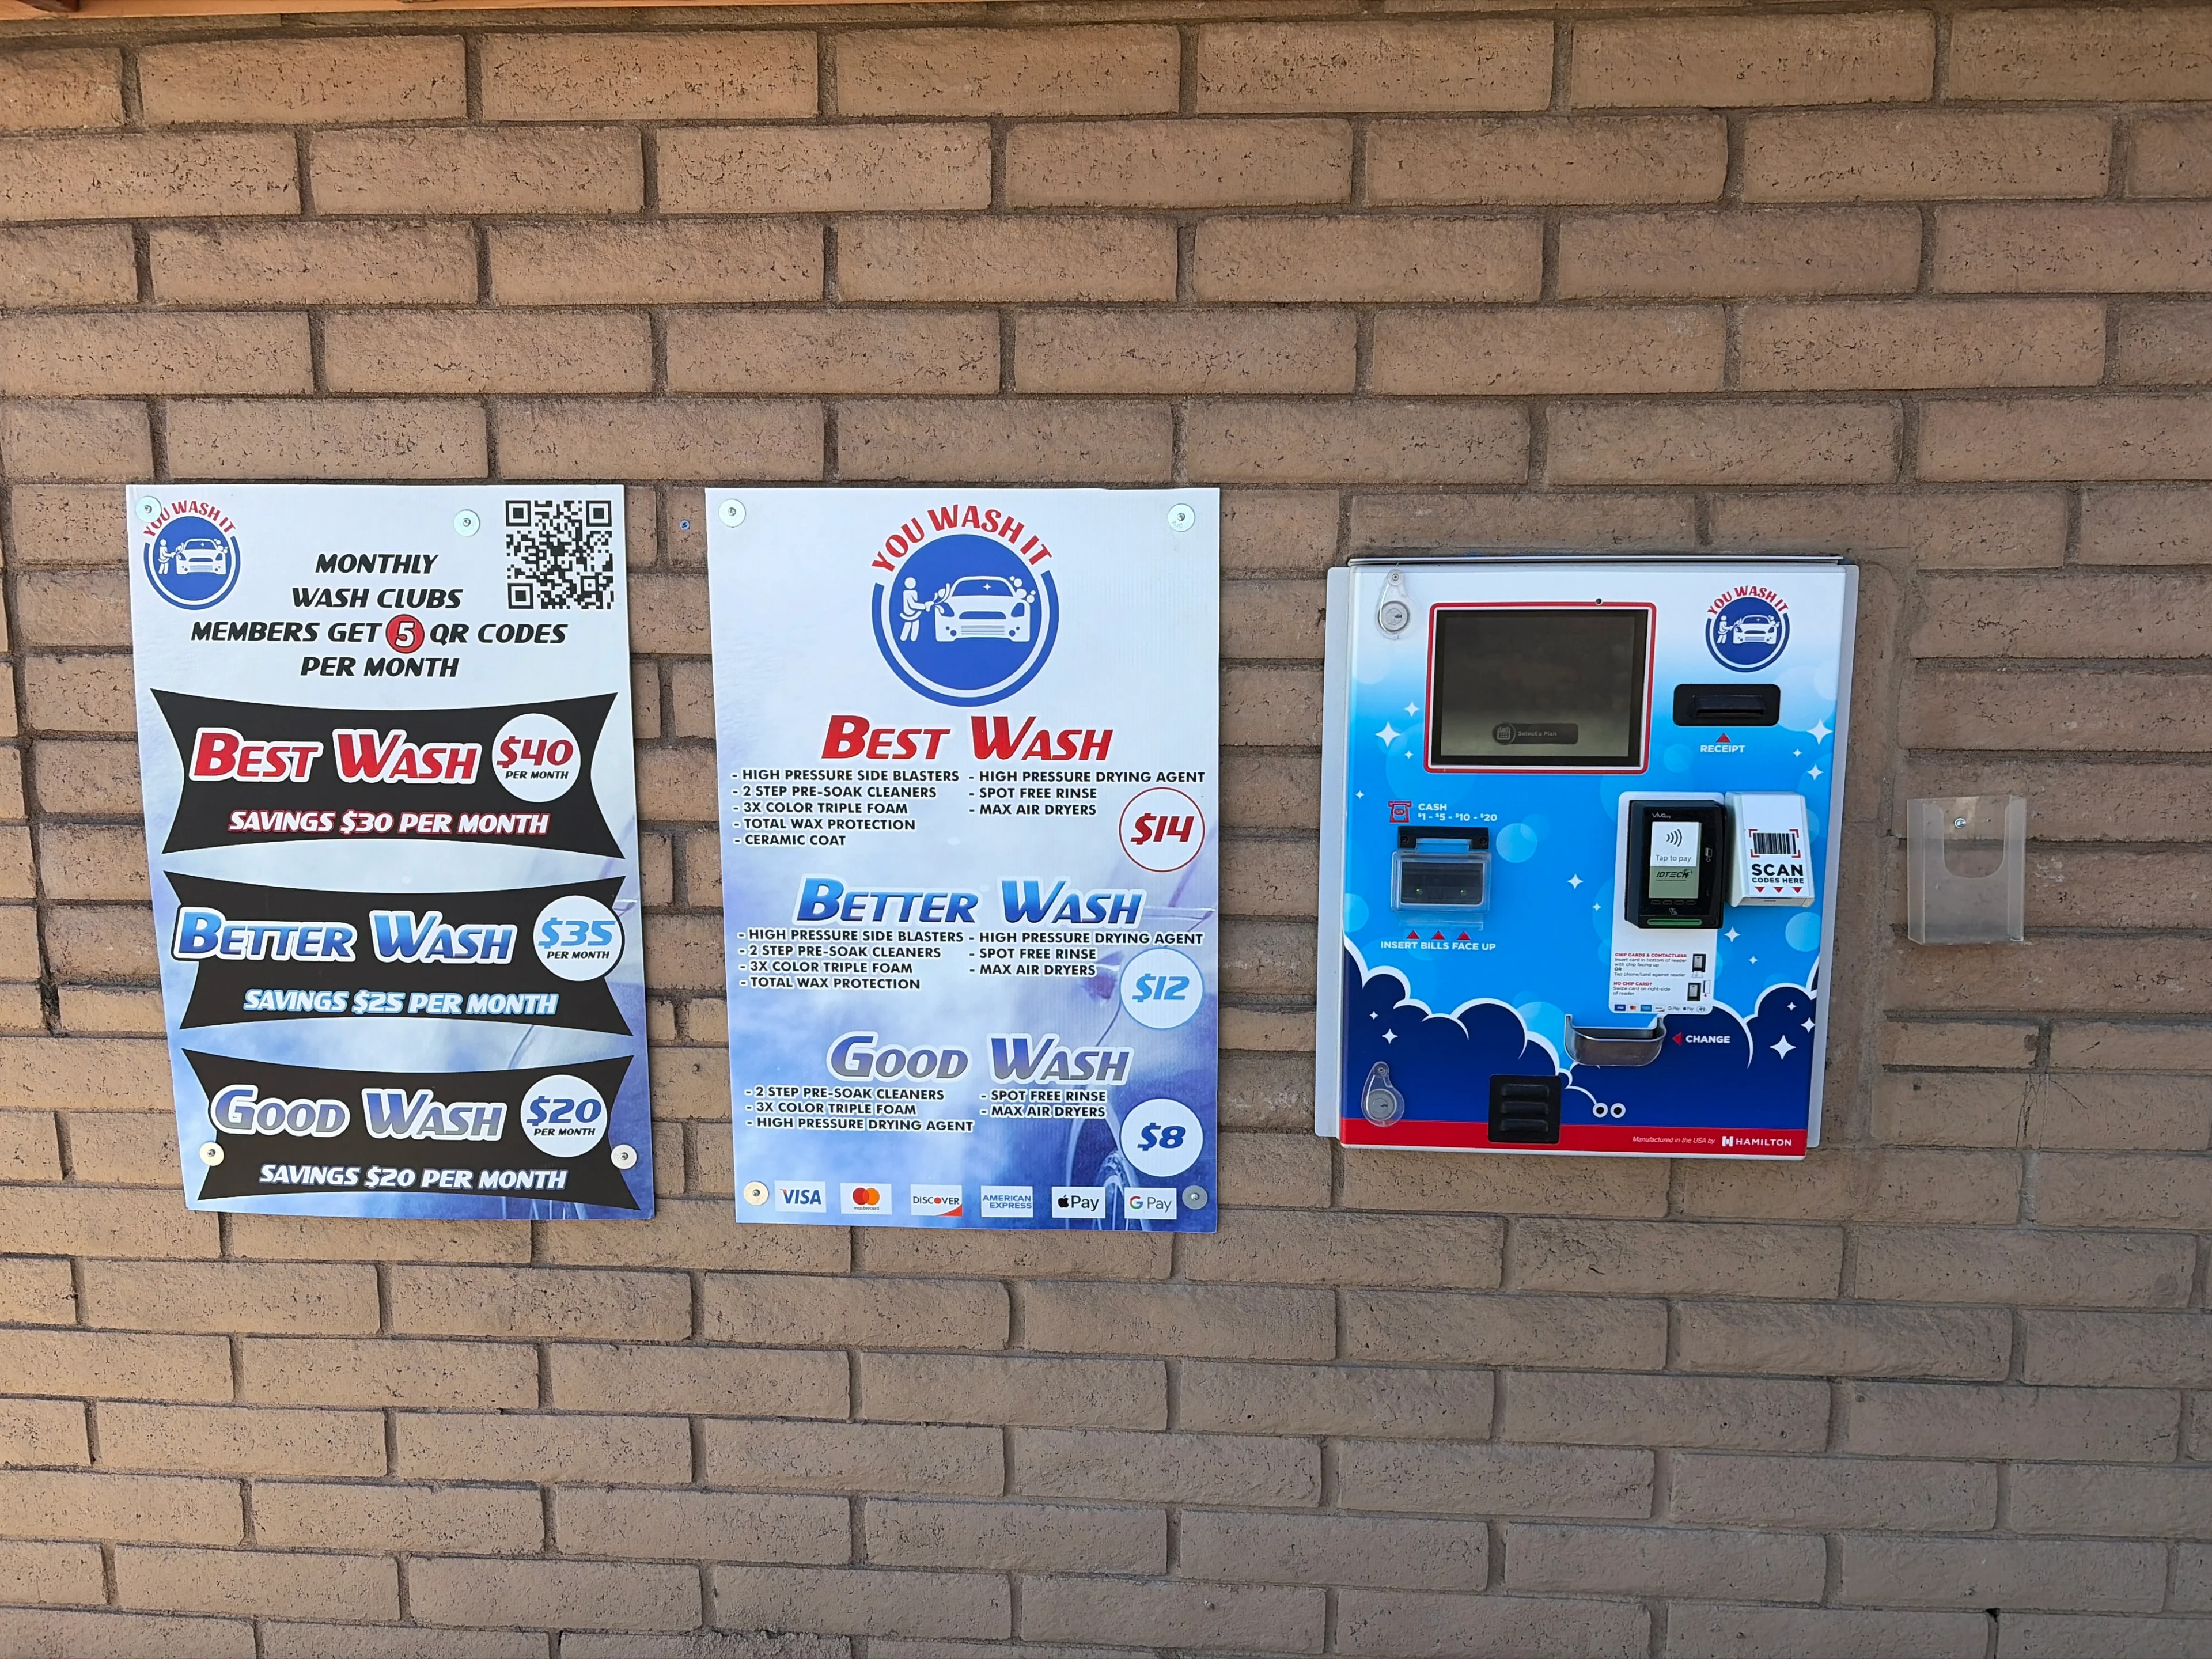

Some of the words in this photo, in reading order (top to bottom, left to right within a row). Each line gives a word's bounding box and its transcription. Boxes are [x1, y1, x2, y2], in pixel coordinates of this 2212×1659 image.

[172, 500, 221, 521] WASH
[219, 517, 236, 532] IT
[871, 518, 925, 572] YOU
[927, 504, 1024, 544] WASH
[1020, 535, 1052, 565] IT
[315, 553, 439, 574] MONTHLY
[293, 588, 370, 608] WASH
[377, 589, 463, 608] CLUBS
[1707, 591, 1732, 615] YOU
[1734, 585, 1777, 603] WASH
[1774, 599, 1789, 612] IT
[191, 622, 320, 642] MEMBERS
[328, 623, 382, 642] GET
[395, 622, 415, 648] 5
[430, 623, 470, 646] QR
[478, 624, 568, 643] CODES
[301, 657, 356, 676] PER
[364, 657, 460, 677] MONTH
[821, 715, 950, 760] BEST
[971, 715, 1113, 761] WASH
[192, 730, 323, 779] BEST
[335, 733, 480, 782] WASH
[495, 737, 574, 767] $40
[1700, 744, 1745, 753] RECEIPT
[505, 771, 525, 779] PER
[528, 771, 569, 779] MONTH
[743, 770, 779, 780] HIGH
[785, 770, 852, 781] PRESSURE
[858, 771, 887, 781] SIDE
[893, 771, 959, 781] BLASTERS
[979, 771, 1017, 782] HIGH
[1022, 772, 1090, 782] PRESSURE
[1096, 772, 1151, 782] DRYING
[1156, 772, 1205, 782] AGENT
[743, 786, 751, 796] 2
[756, 787, 787, 796] STEP
[792, 787, 862, 797] PRE-SOAK
[867, 787, 936, 797] CLEANERS
[979, 788, 1014, 798] SPOT
[1020, 788, 1051, 798] FREE
[1056, 788, 1097, 798] RINSE
[744, 802, 762, 812] 3X
[766, 803, 813, 813] COLOR
[817, 803, 862, 813] TRIPLE
[867, 804, 907, 813] FOAM
[980, 804, 1012, 814] MAX
[1016, 805, 1039, 815] AIR
[1045, 805, 1096, 815] DRYERS
[228, 810, 336, 832] SAVINGS
[340, 811, 392, 834] $30
[400, 812, 453, 834] PER
[458, 813, 551, 834] MONTH
[744, 819, 786, 829] TOTAL
[791, 819, 823, 829] WAX
[828, 820, 915, 830] PROTECTION
[1131, 813, 1194, 845] $14
[745, 835, 805, 845] CERAMIC
[810, 836, 846, 846] COAT
[1752, 864, 1803, 876] SCAN
[796, 878, 979, 923] BETTER
[1001, 880, 1143, 925] WASH
[179, 911, 355, 959] BETTER
[373, 914, 514, 961] WASH
[538, 918, 615, 948] $35
[749, 930, 786, 940] HIGH
[791, 930, 858, 941] PRESSURE
[863, 931, 892, 941] SIDE
[898, 931, 963, 942] BLASTERS
[547, 950, 569, 959] PER
[572, 950, 609, 959] MONTH
[749, 946, 757, 955] 2
[762, 946, 793, 956] STEP
[798, 946, 868, 956] PRE-SOAK
[873, 947, 941, 957] CLEANERS
[1132, 974, 1189, 1003] $12
[244, 990, 347, 1012] SAVINGS
[353, 990, 404, 1013] $25
[410, 991, 462, 1014] PER
[465, 992, 559, 1015] MONTH
[1685, 1035, 1730, 1044] CHANGE
[830, 1036, 968, 1079] GOOD
[991, 1037, 1130, 1082] WASH
[991, 1090, 1026, 1101] SPOT
[1031, 1091, 1060, 1101] FREE
[1066, 1092, 1105, 1101] RINSE
[215, 1089, 346, 1134] GOOD
[366, 1092, 503, 1137] WASH
[526, 1097, 601, 1127] $20
[533, 1128, 555, 1136] PER
[559, 1128, 595, 1137] MONTH
[1137, 1123, 1186, 1151] $8
[1736, 1138, 1791, 1146] HAMILTON
[259, 1164, 360, 1186] SAVINGS
[366, 1165, 415, 1188] $20
[422, 1166, 474, 1189] PER
[479, 1168, 568, 1190] MONTH
[780, 1188, 821, 1205] VISA
[913, 1196, 959, 1205] DISCOVER
[1071, 1195, 1099, 1211] Pay
[1147, 1196, 1172, 1213] Pay
